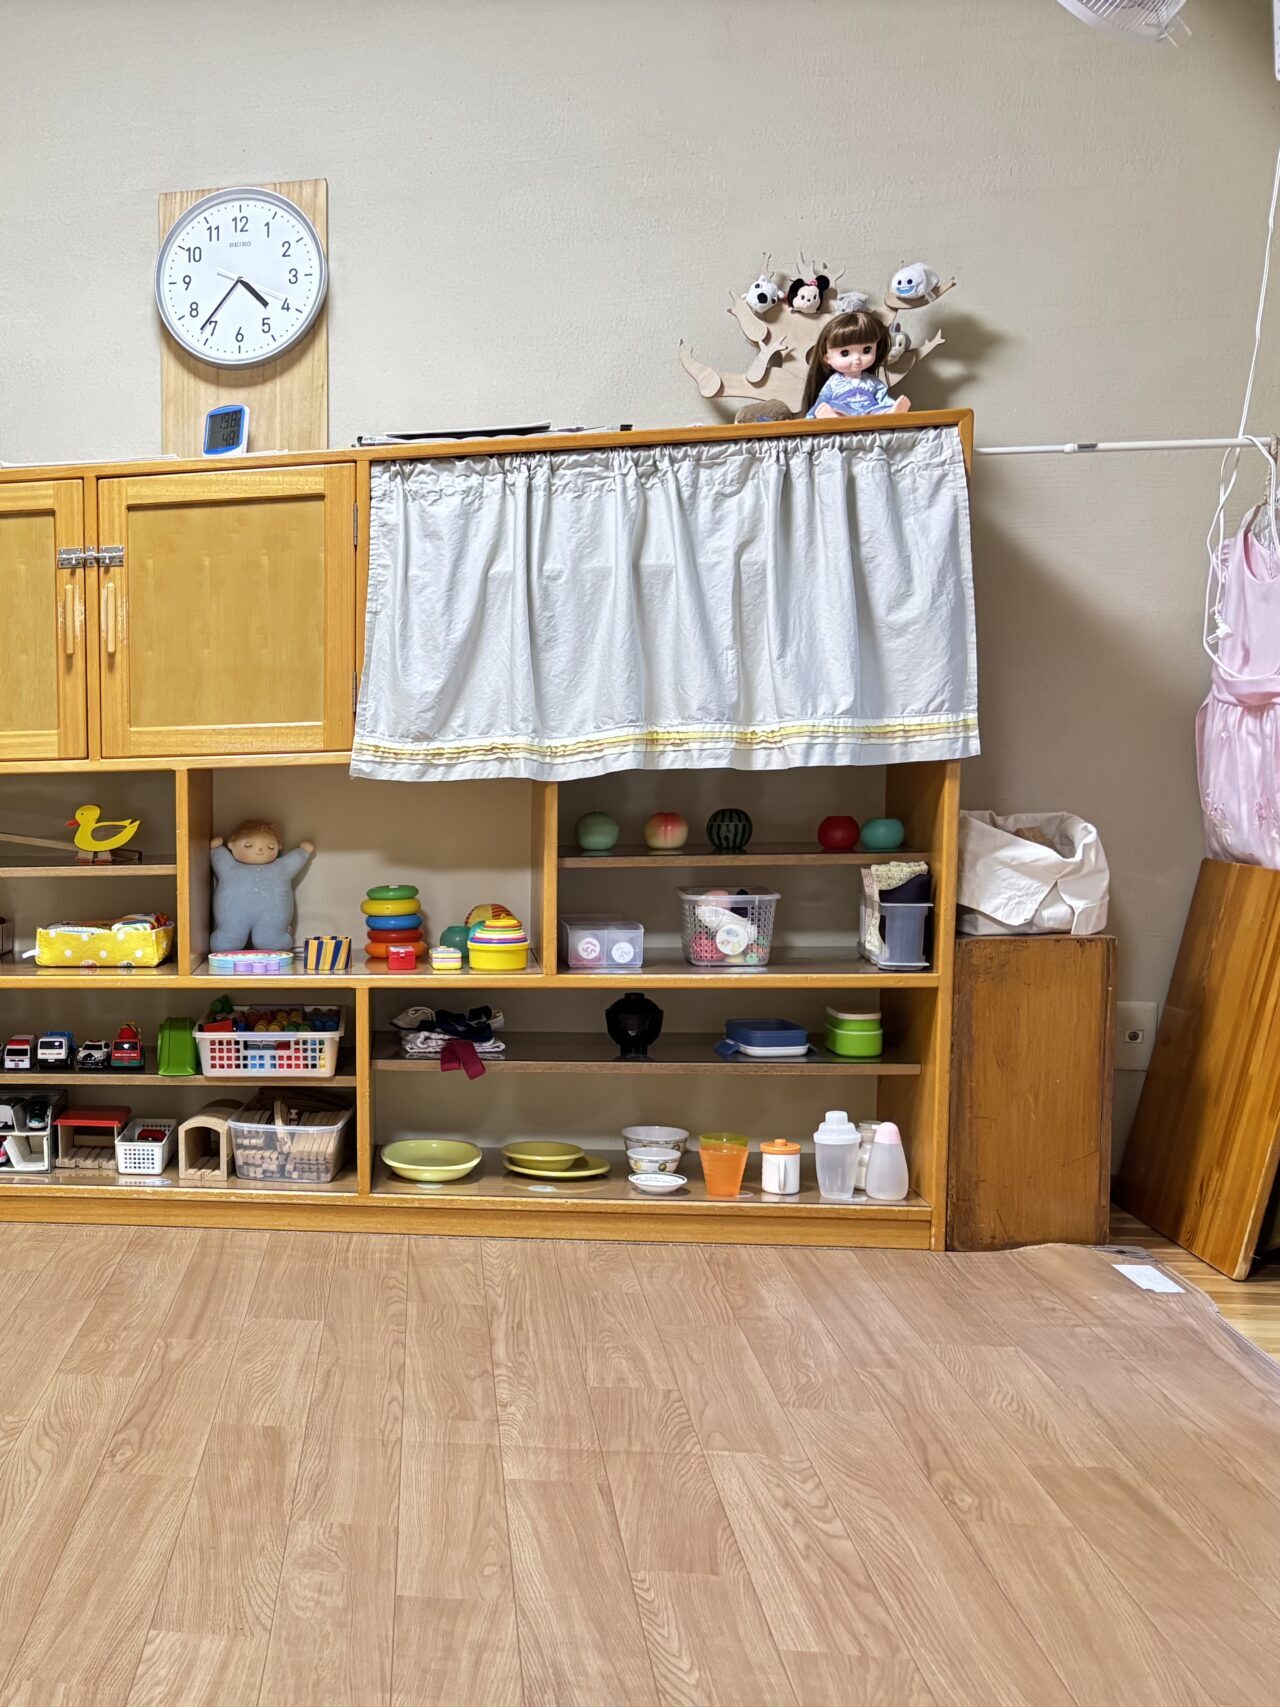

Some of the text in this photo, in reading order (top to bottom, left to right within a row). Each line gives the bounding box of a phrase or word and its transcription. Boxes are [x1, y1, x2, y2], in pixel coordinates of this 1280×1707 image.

[231, 216, 249, 233] 12
[263, 221, 271, 239] 1
[206, 226, 220, 242] 11
[185, 246, 202, 263] 10
[281, 241, 292, 258] 2
[182, 275, 192, 292] 9
[288, 268, 298, 285] 3
[189, 301, 199, 318] 8
[280, 298, 291, 313] 4
[208, 320, 218, 337] 7
[261, 317, 272, 334] 5
[234, 326, 245, 343] 6
